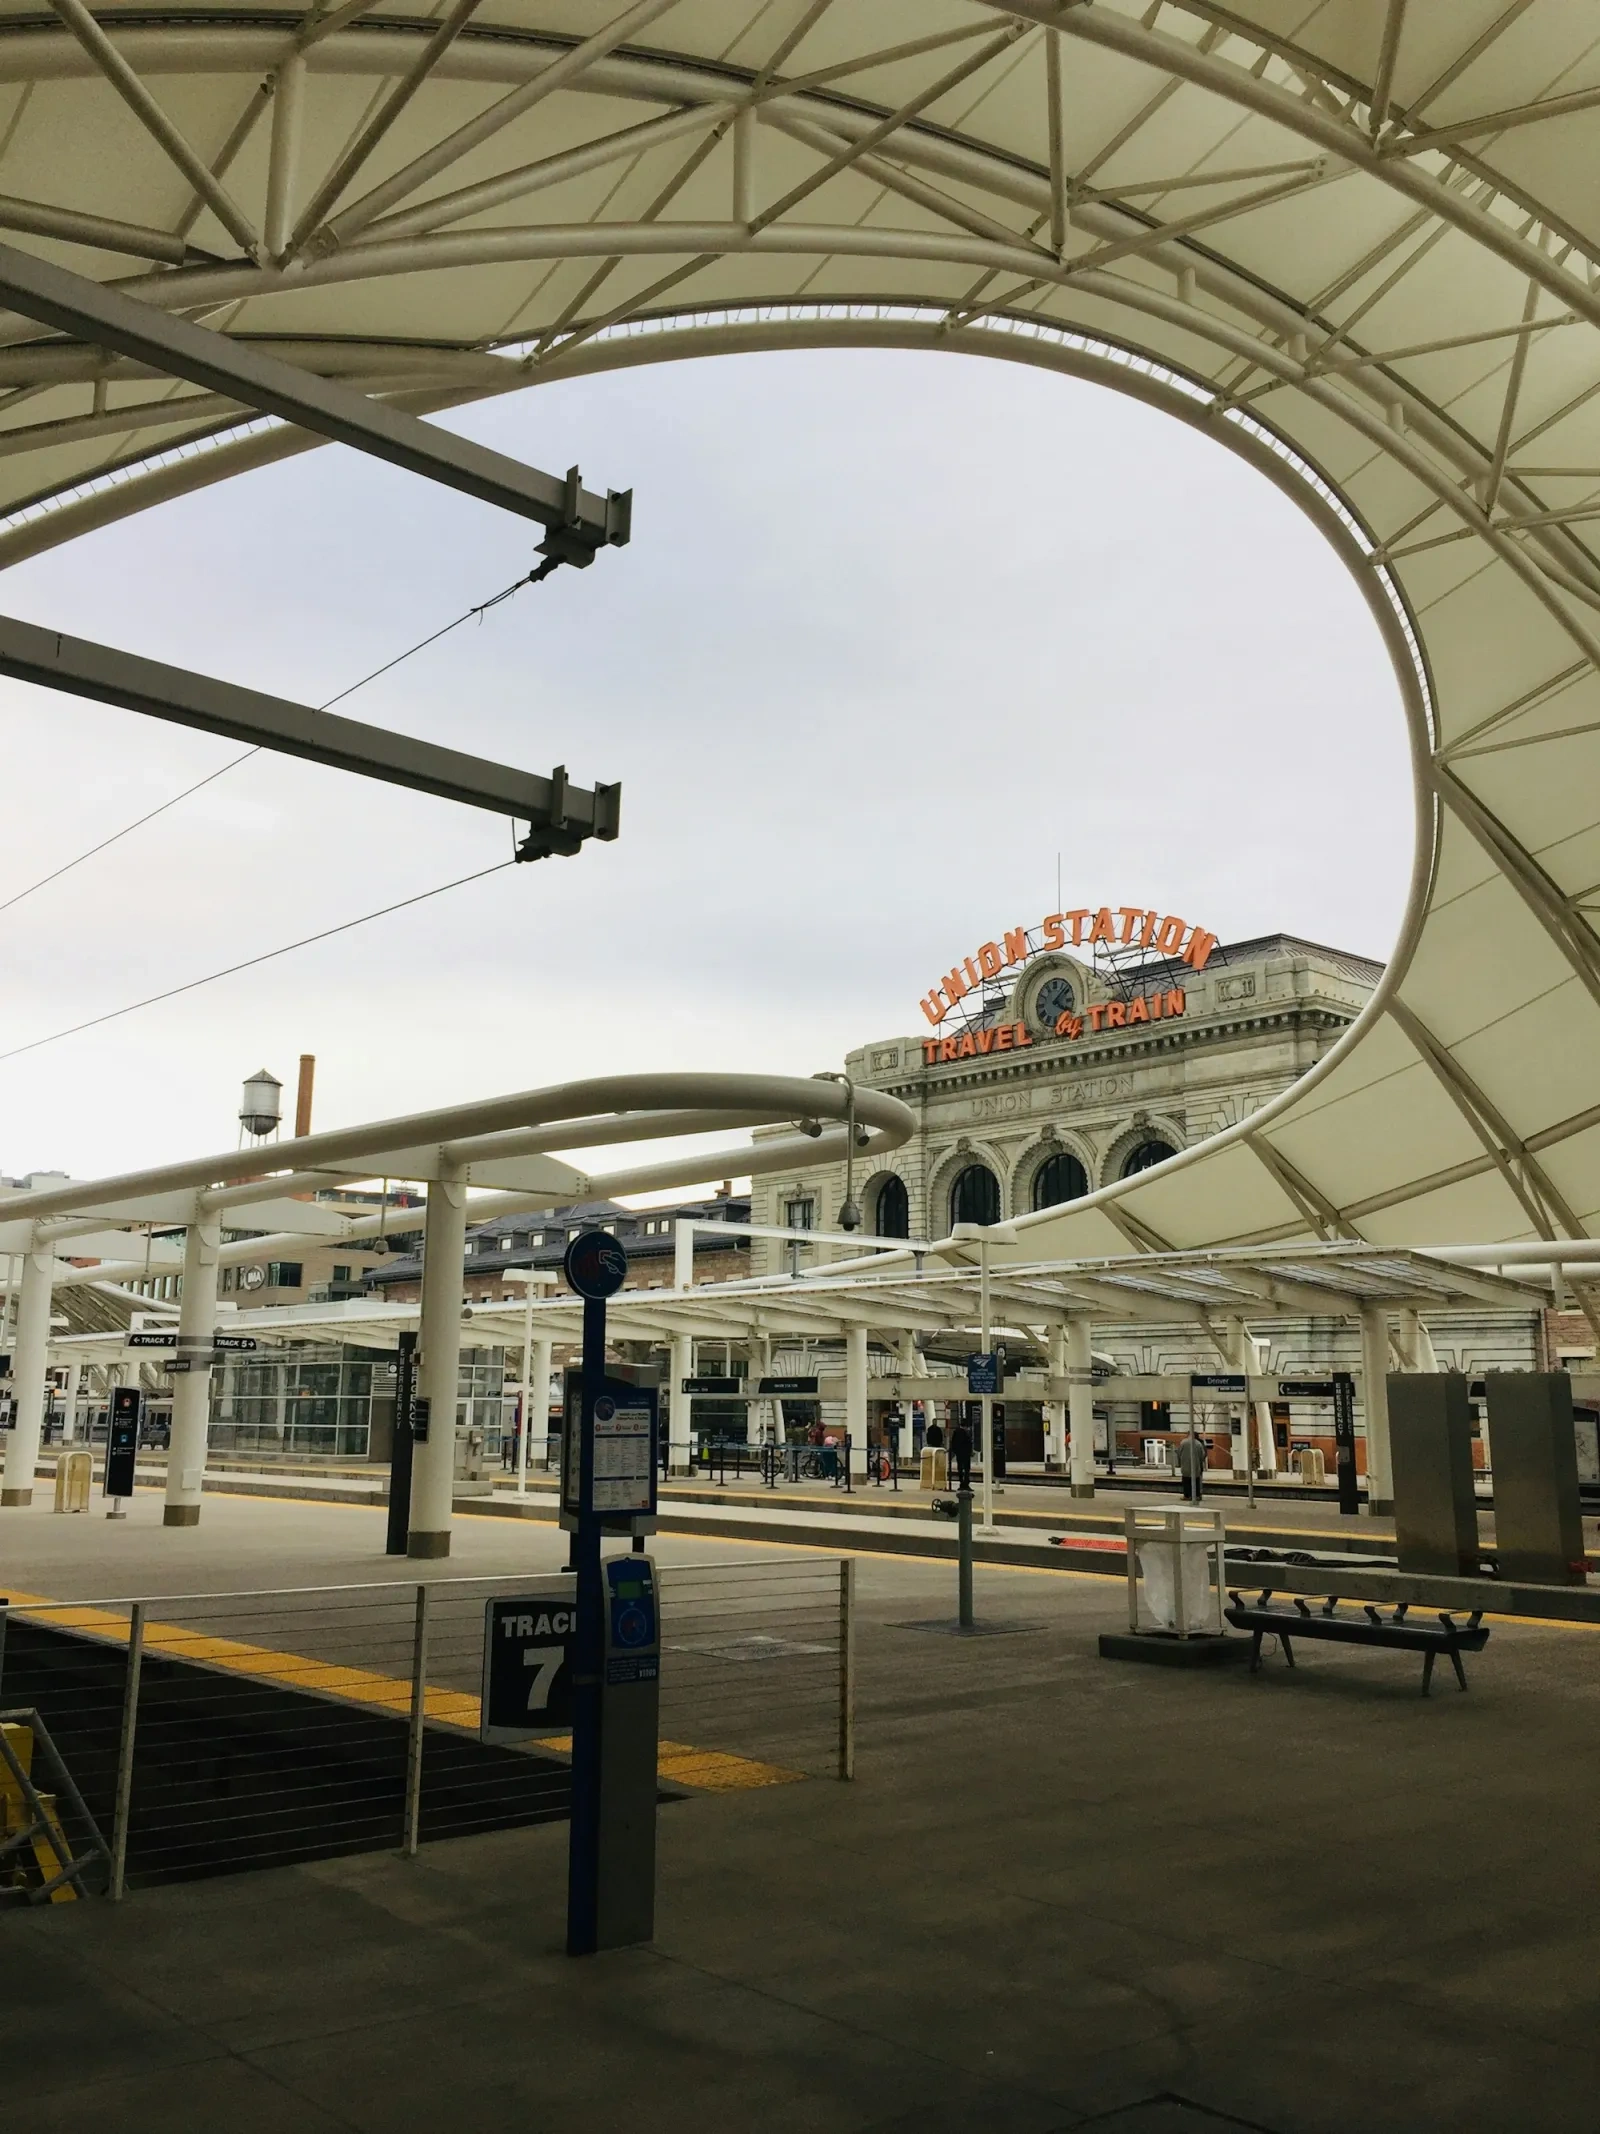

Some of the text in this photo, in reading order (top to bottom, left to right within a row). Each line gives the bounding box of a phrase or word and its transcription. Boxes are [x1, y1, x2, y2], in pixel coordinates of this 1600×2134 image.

[920, 906, 1218, 1026] UNION STATION
[923, 988, 1185, 1064] TRAVEL by TRAIN
[971, 1073, 1134, 1117] UNION STATION
[1207, 1376, 1229, 1385] Denver
[1335, 1383, 1344, 1436] EMERGENCY
[523, 1646, 565, 1711] 7
